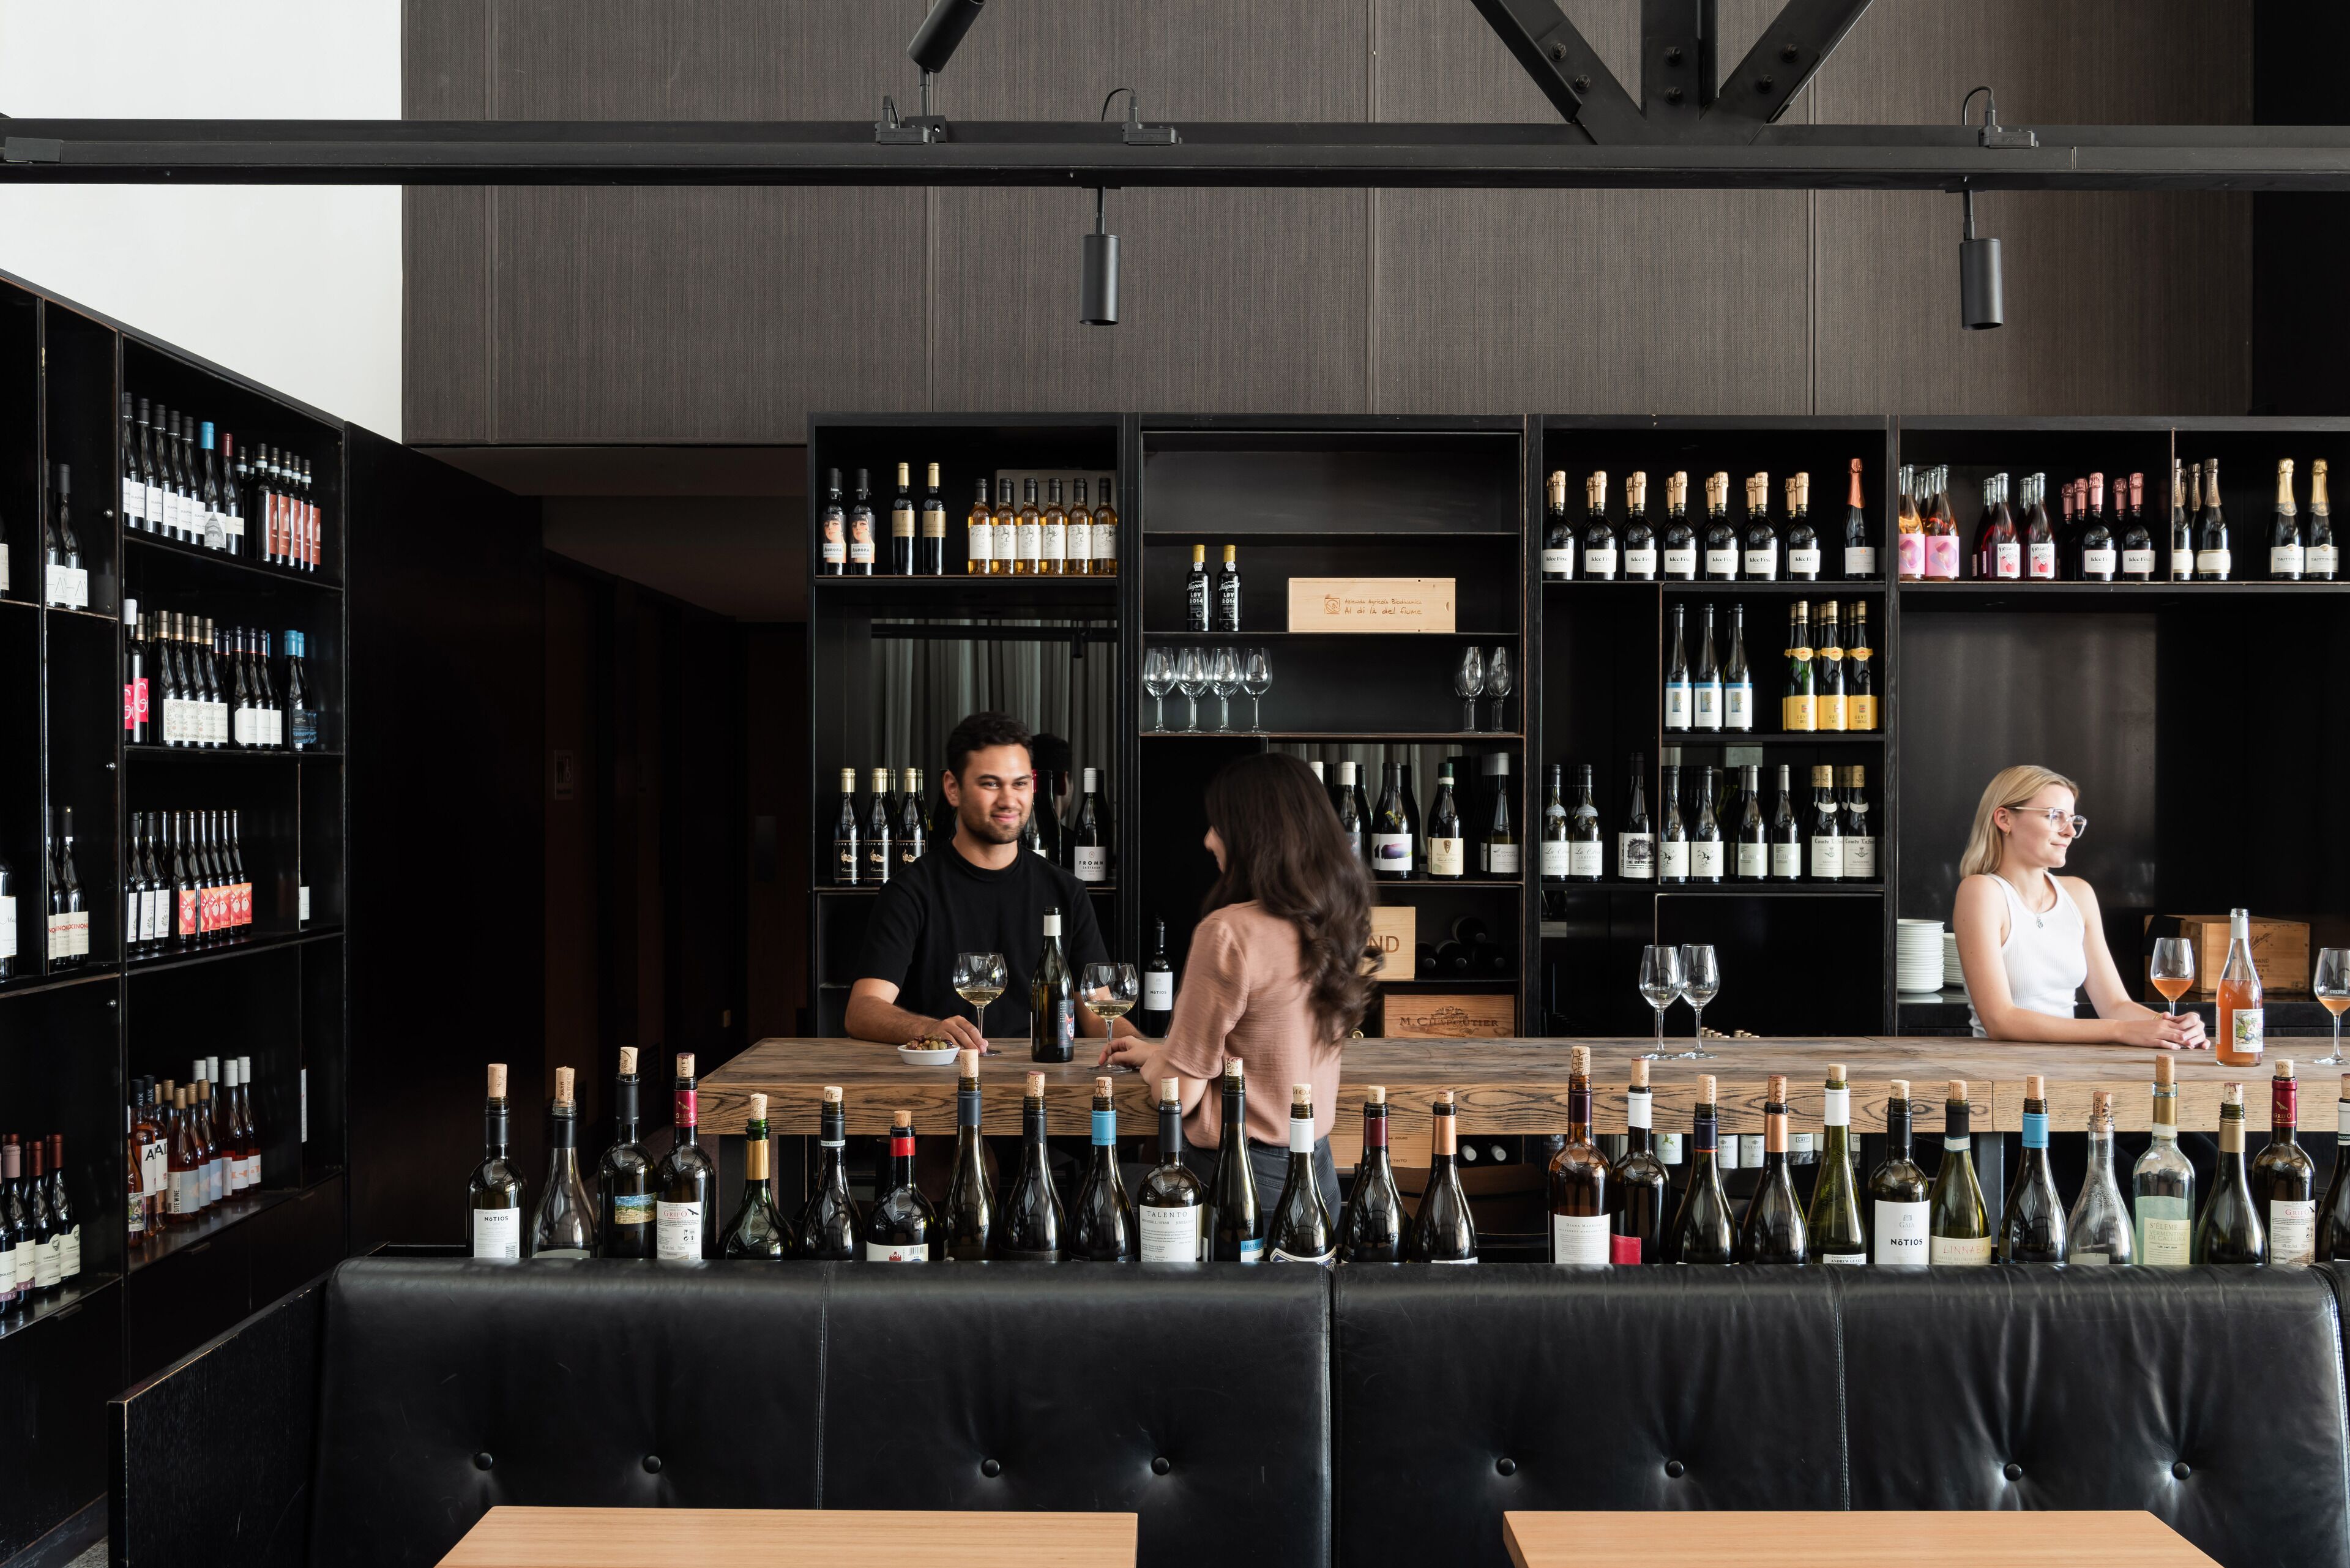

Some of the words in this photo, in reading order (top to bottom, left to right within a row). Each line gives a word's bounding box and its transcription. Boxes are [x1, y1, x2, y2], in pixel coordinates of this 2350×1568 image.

[1400, 607, 1423, 615] fiume
[1417, 1017, 1499, 1027] CHAPOUTIER
[1943, 1244, 1986, 1254] LINNAEA
